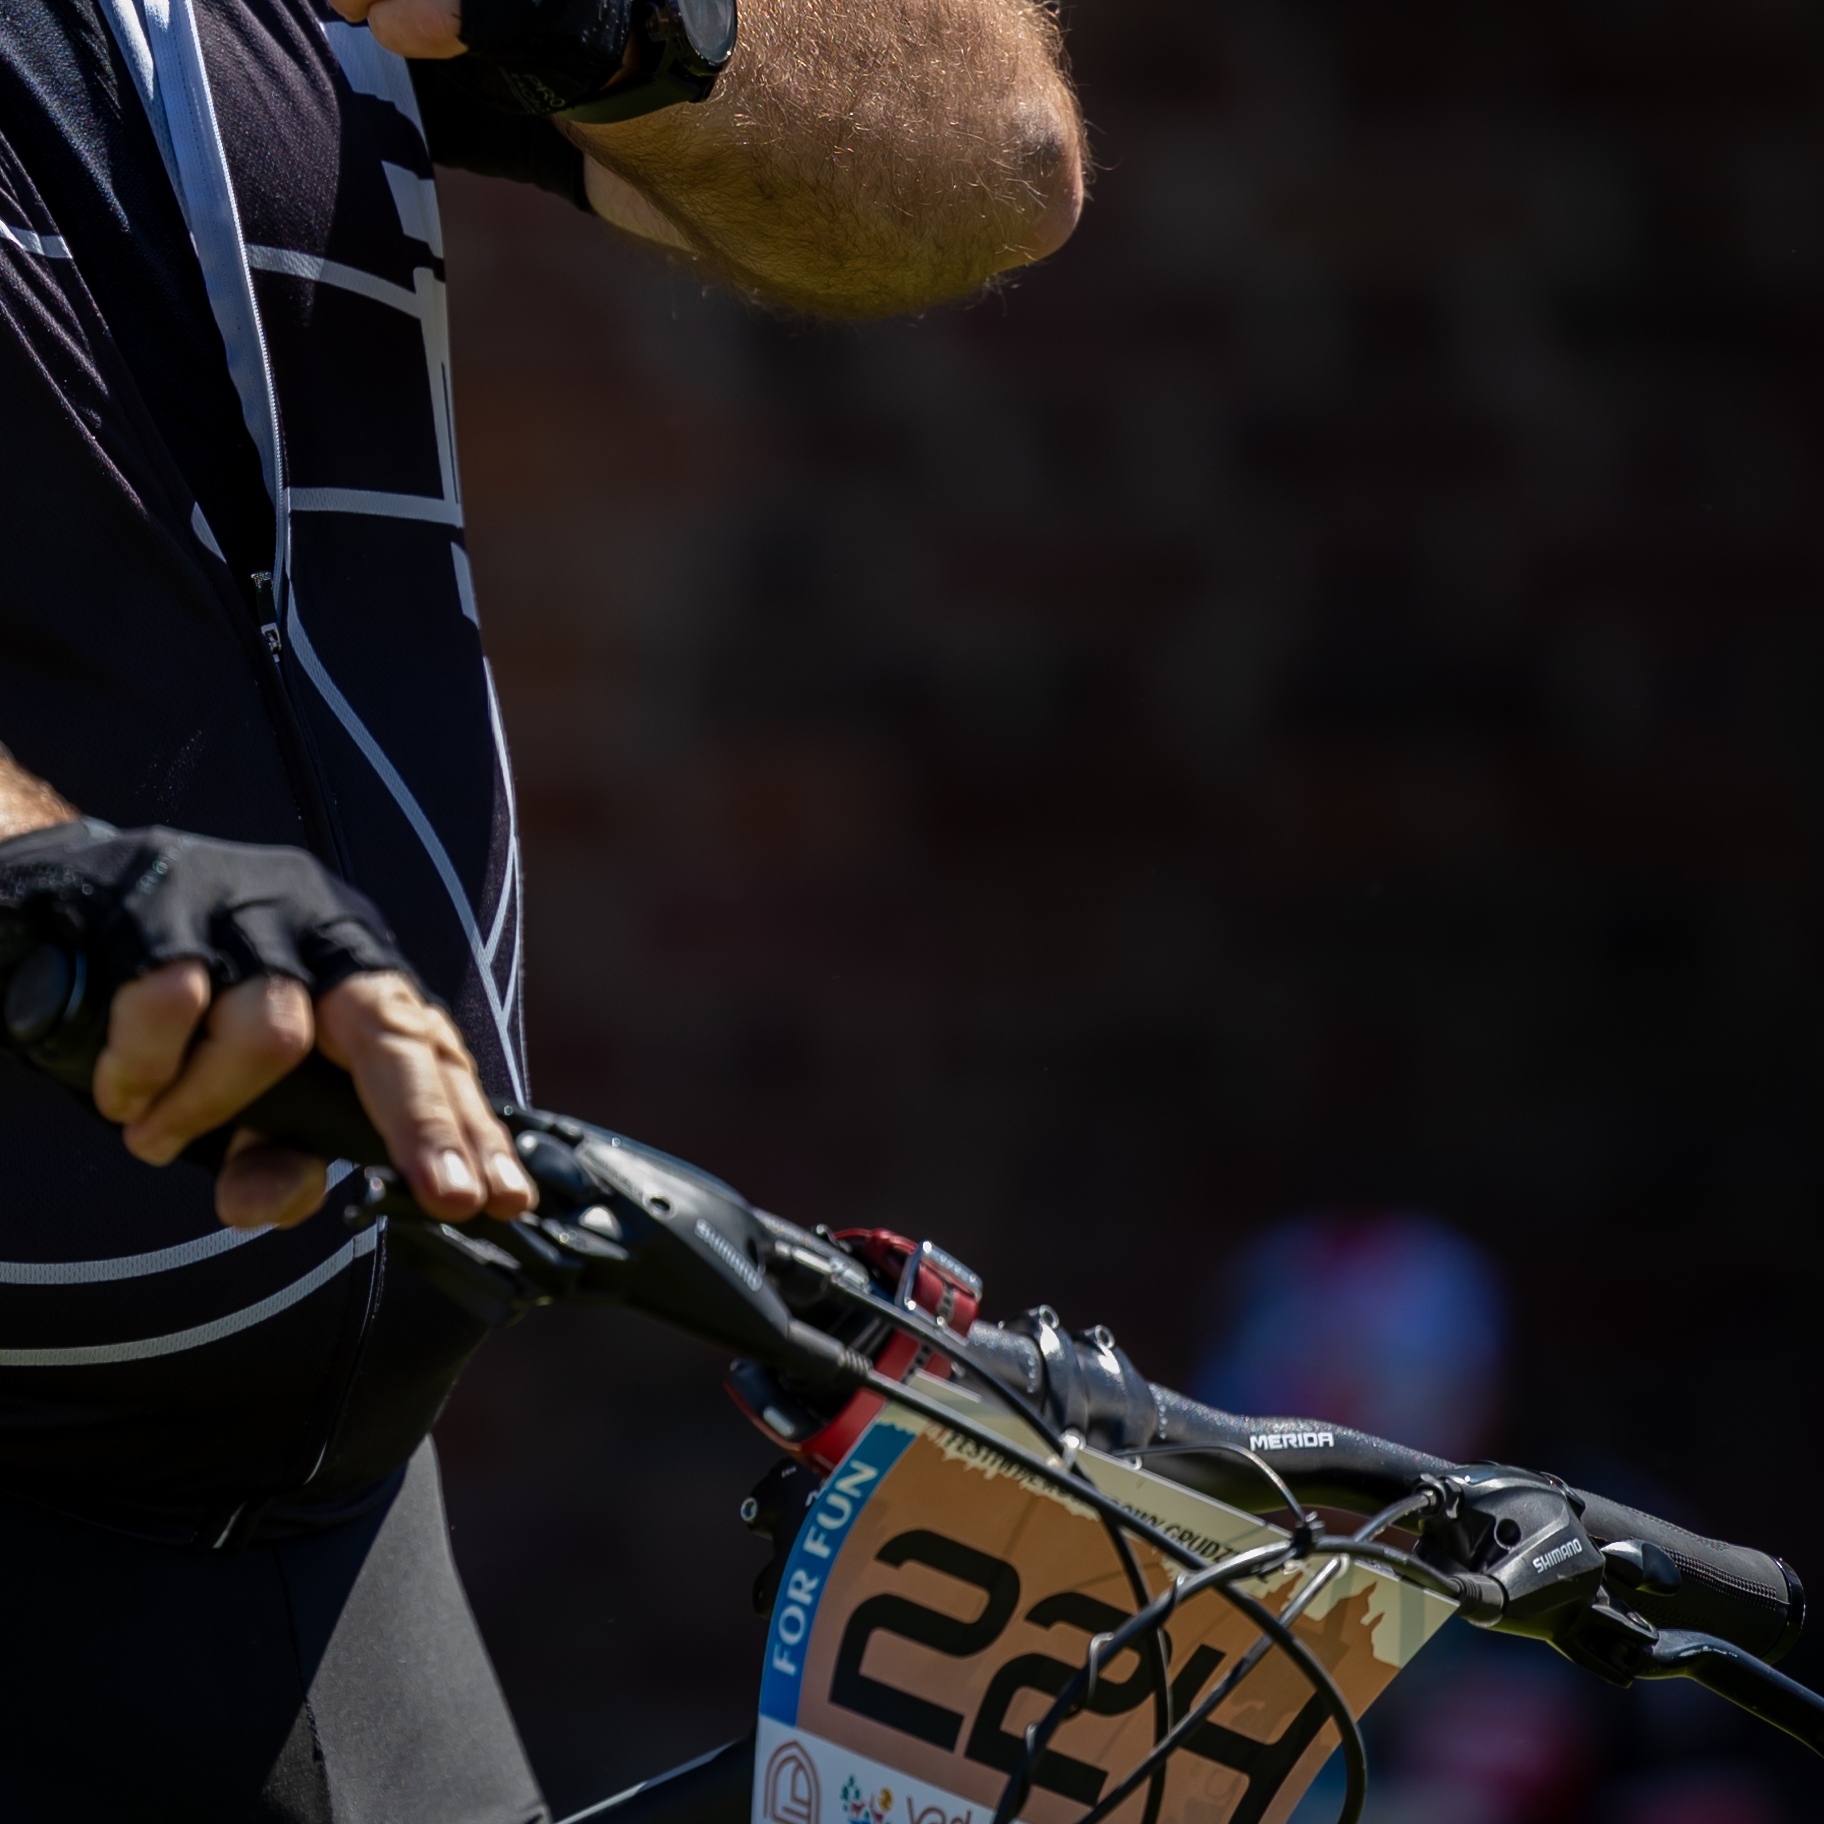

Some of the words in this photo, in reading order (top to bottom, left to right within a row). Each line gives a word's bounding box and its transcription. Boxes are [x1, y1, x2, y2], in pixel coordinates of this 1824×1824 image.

[1249, 1430, 1335, 1451] MERIDA
[772, 1567, 819, 1677] FOR
[803, 1459, 879, 1560] FUN
[1531, 1536, 1583, 1575] SHIMANO
